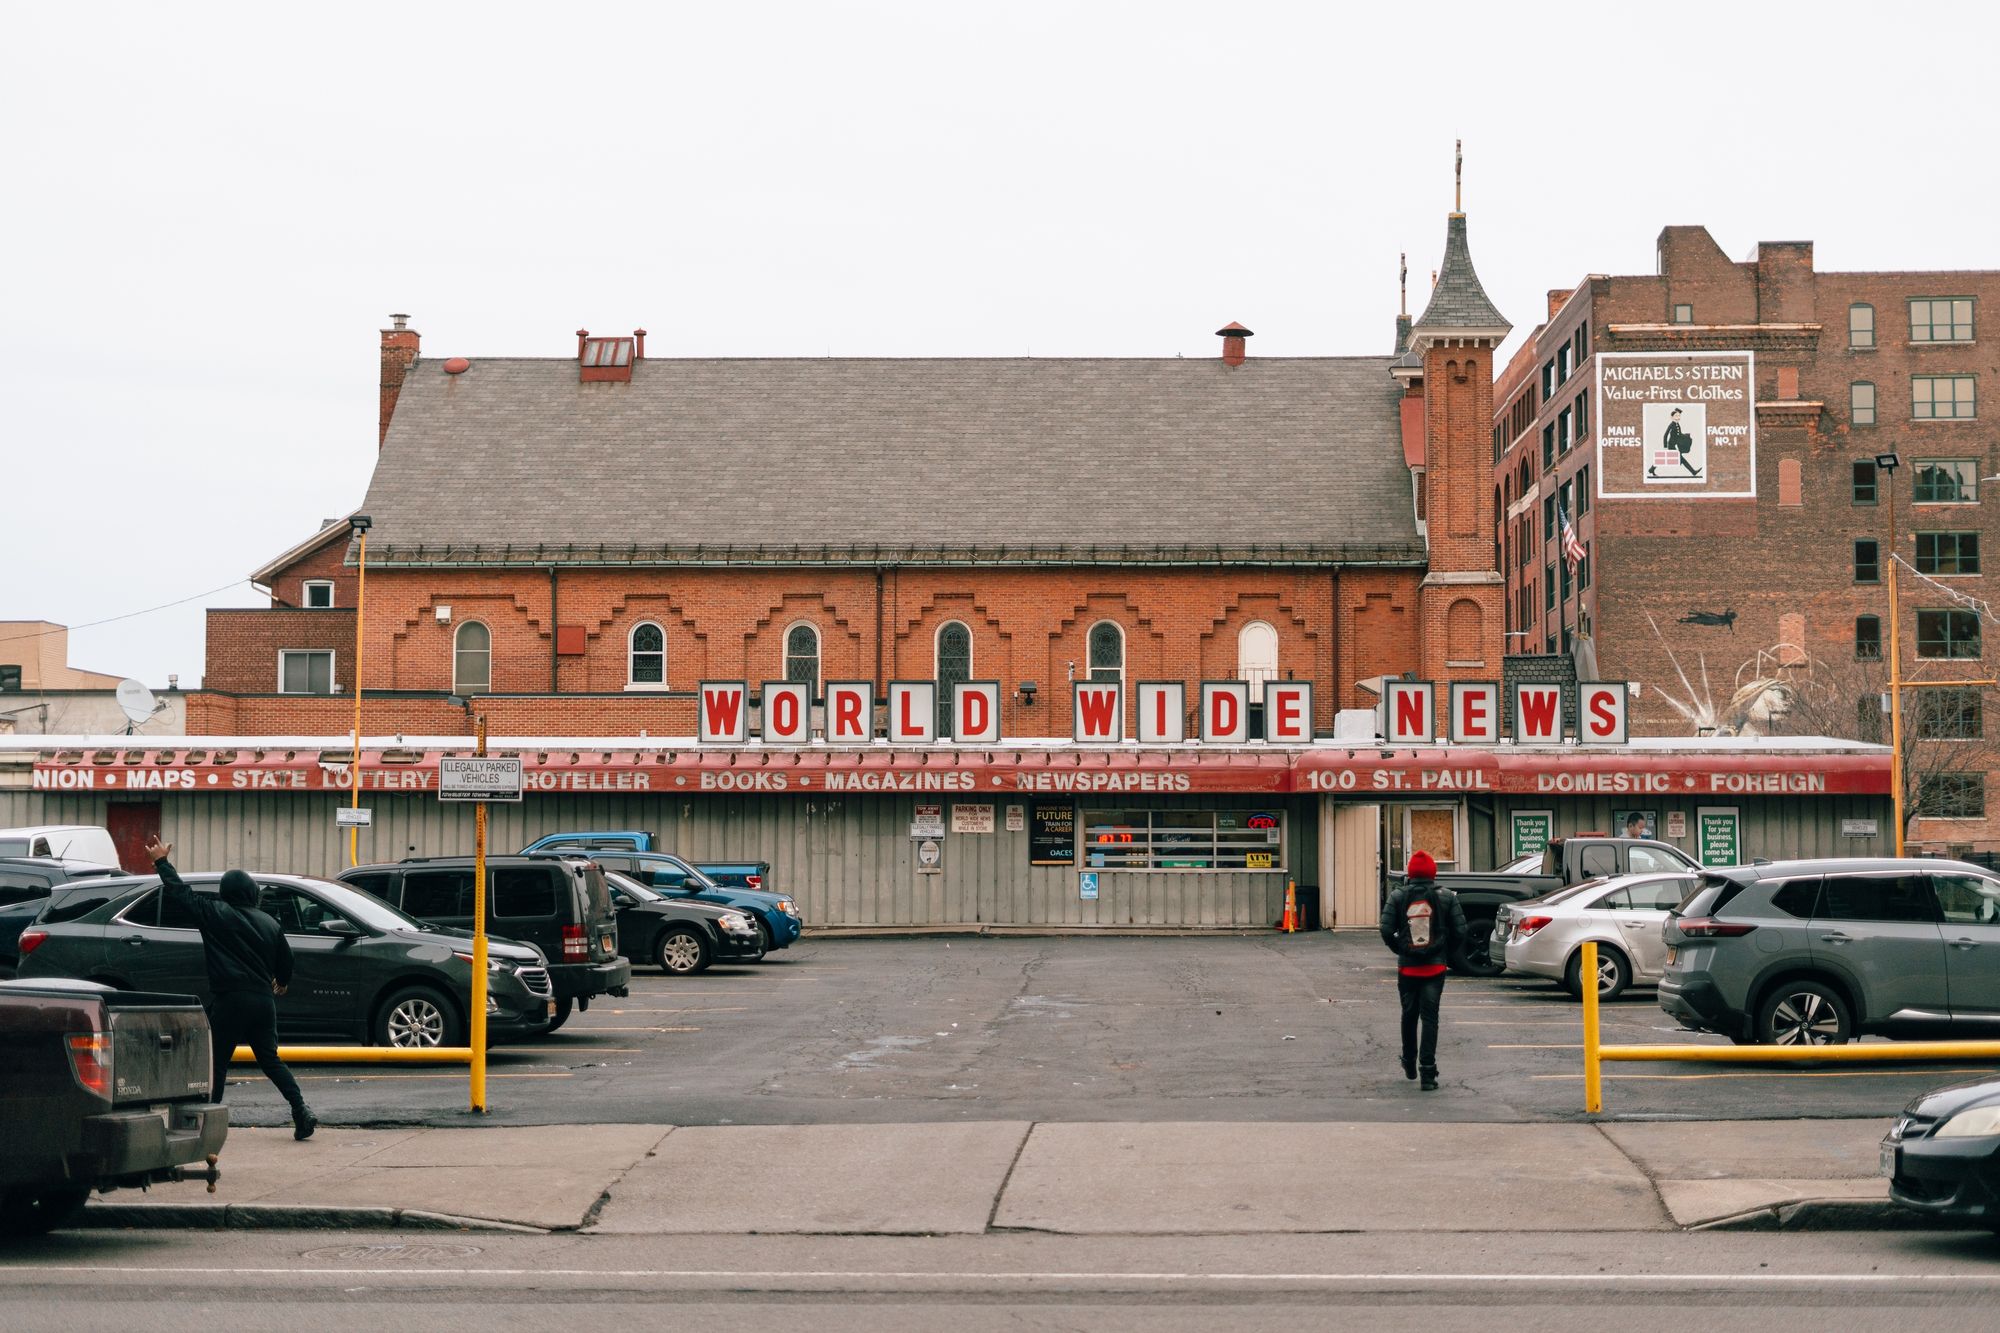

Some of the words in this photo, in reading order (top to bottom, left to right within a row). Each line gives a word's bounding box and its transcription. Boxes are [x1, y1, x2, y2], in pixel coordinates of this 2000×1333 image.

[1687, 385, 1742, 400] Clothes
[1608, 426, 1635, 436] MAIN
[1707, 426, 1748, 436] FACTORY
[1602, 437, 1641, 447] OFFICES
[704, 690, 988, 736] WORLD
[1079, 690, 1300, 736] WIDE
[1397, 690, 1616, 736] NEWS
[444, 762, 484, 772] ILLEGALLY
[486, 763, 517, 772] PARKED
[33, 769, 94, 788] NION
[126, 769, 196, 788] MAPS
[232, 770, 307, 788] STATE
[322, 770, 434, 788] LOTTERY
[523, 771, 649, 790] ROTELLER
[701, 772, 788, 790] BOOKS
[825, 771, 975, 790] MAGAZINES
[1017, 772, 1190, 790] NEWSPAPERS
[462, 773, 500, 783] VEHICLES
[1307, 770, 1356, 789] 100
[1373, 770, 1411, 789] ST.
[1421, 770, 1490, 789] PAUL
[1538, 773, 1670, 792] DOMESTIC
[1710, 773, 1825, 792] FOREIGN
[1036, 811, 1072, 820] FUTURE
[1248, 817, 1275, 829] OPEN
[117, 1086, 141, 1096] HONDA
